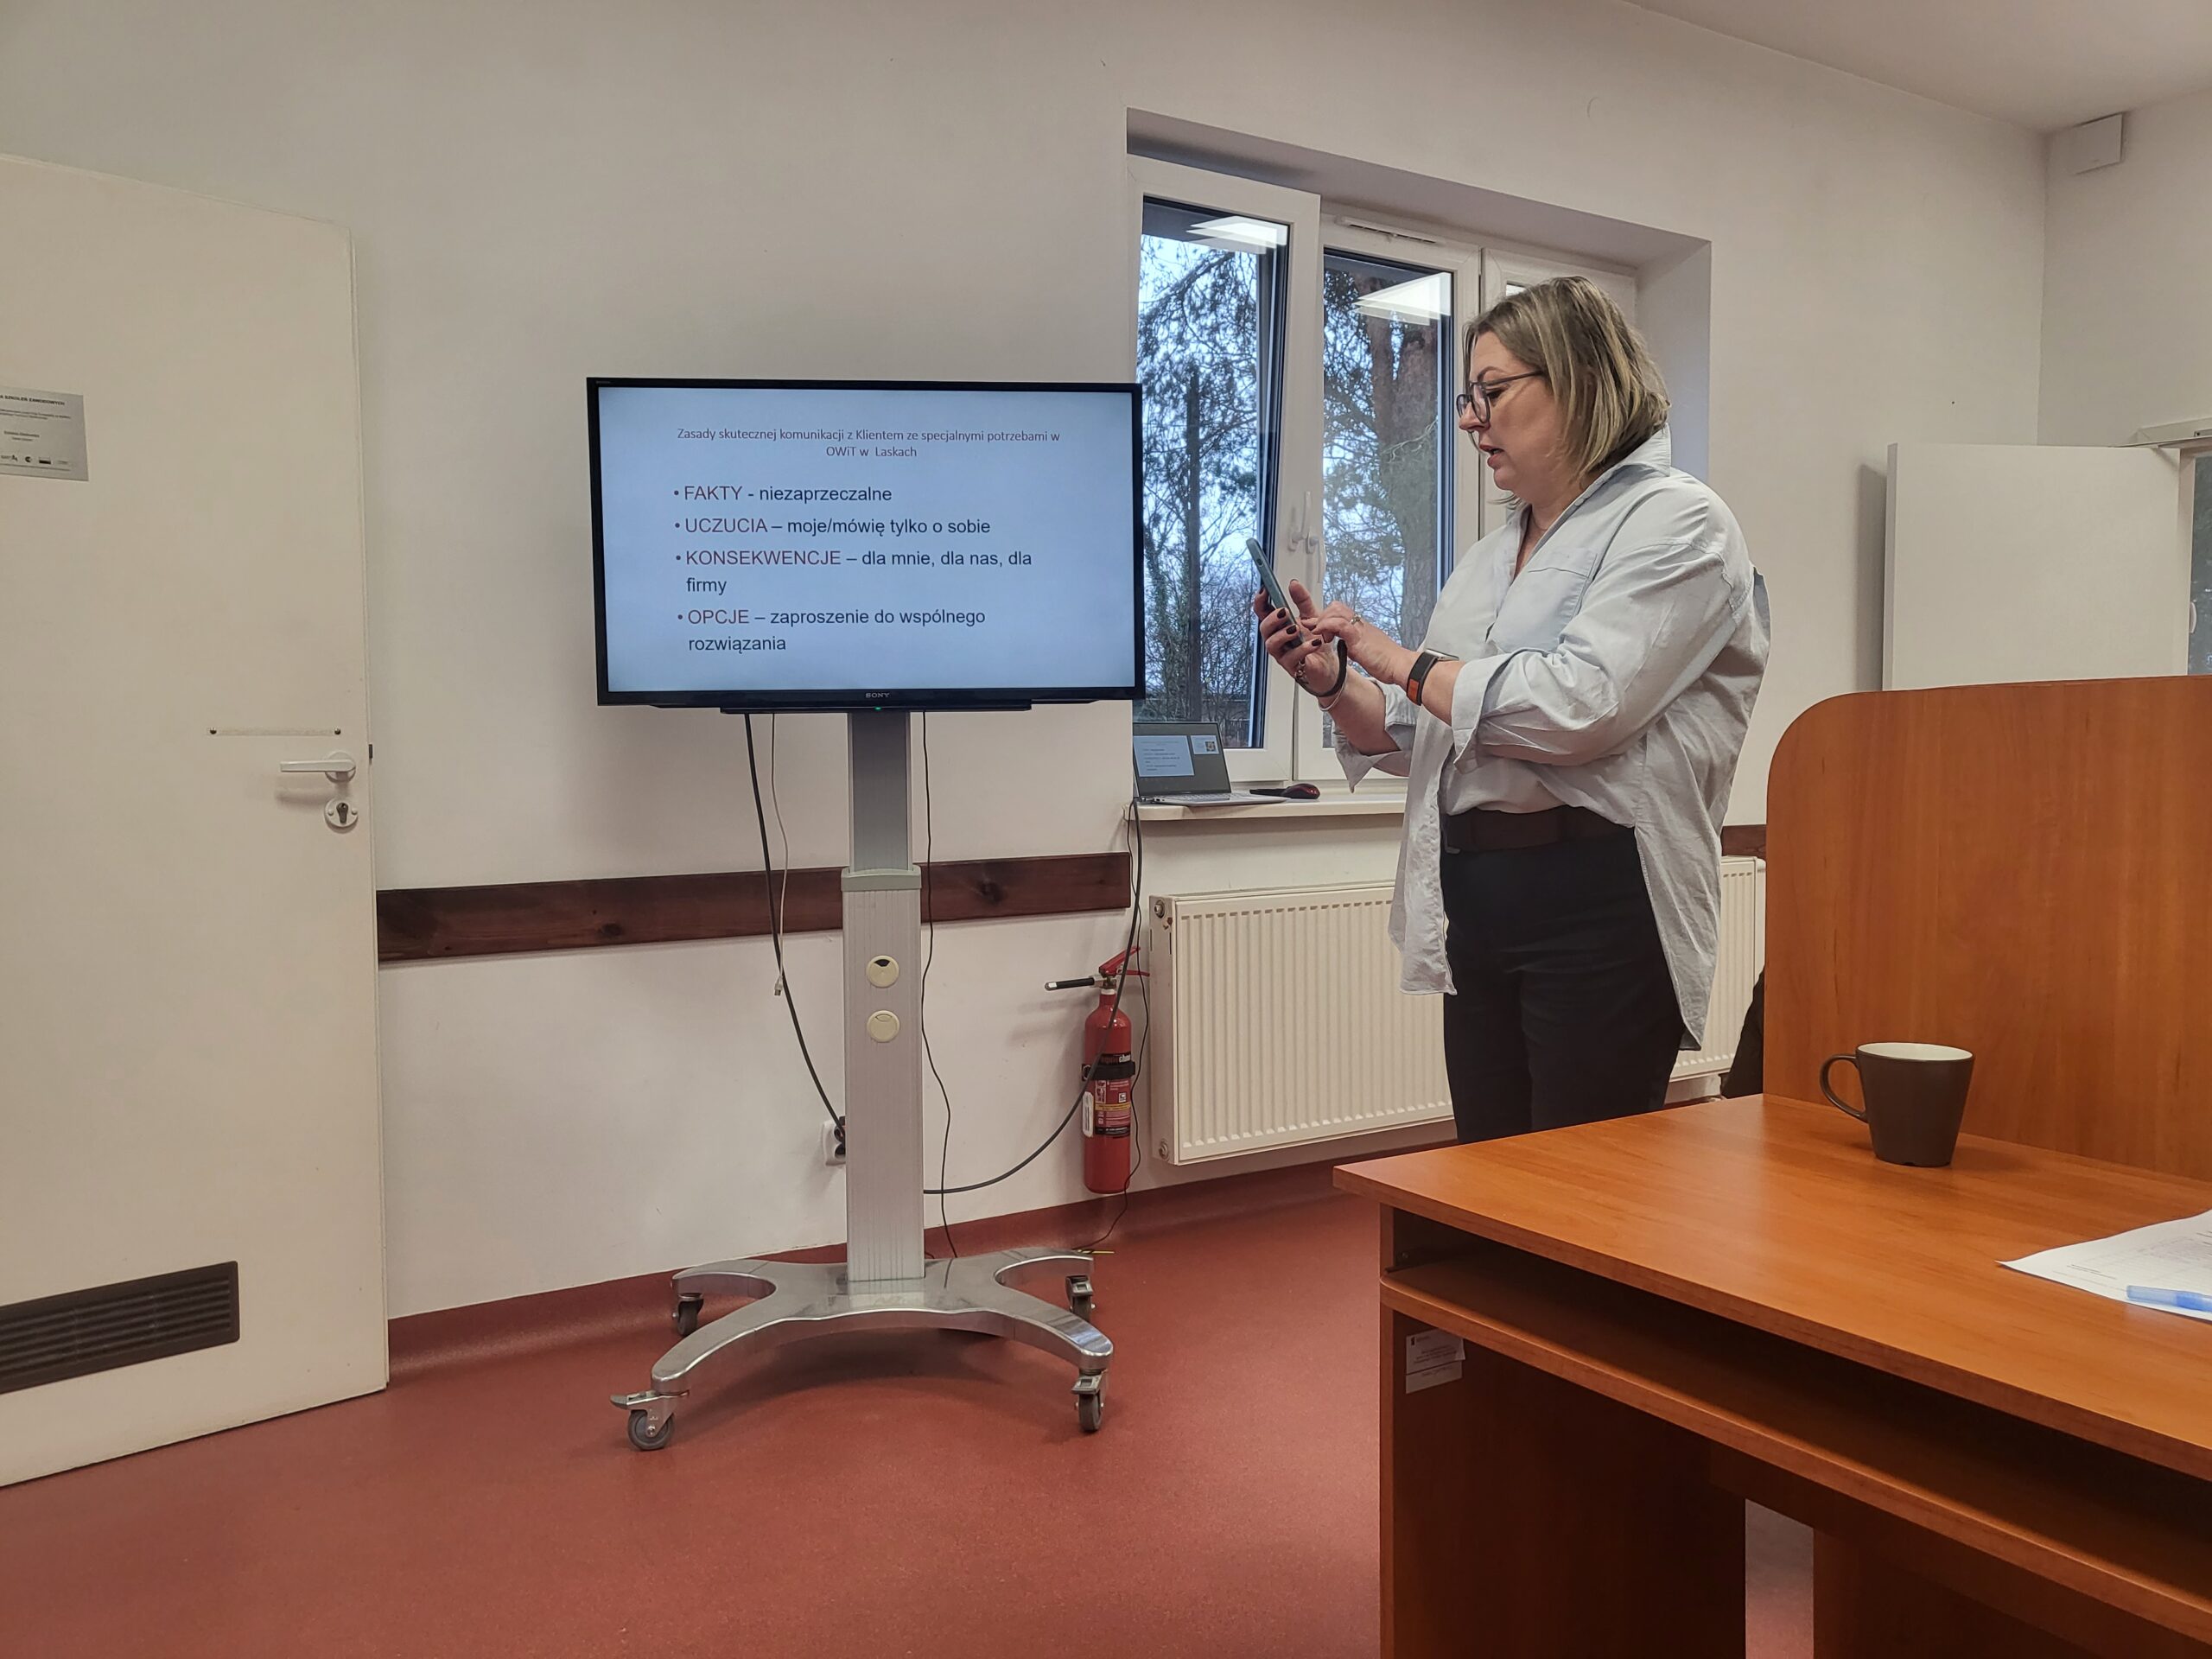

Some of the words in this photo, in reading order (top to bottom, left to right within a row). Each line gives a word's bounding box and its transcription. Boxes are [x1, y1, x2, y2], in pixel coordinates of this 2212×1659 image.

[677, 428, 715, 441] Zasady
[719, 428, 777, 442] skutecznej
[779, 429, 844, 442] komunikacji
[855, 429, 904, 441] Klientem
[921, 430, 984, 442] specjalnymi
[987, 430, 1048, 443] potrzebami
[826, 446, 856, 457] OWiT
[860, 448, 869, 457] w
[875, 446, 918, 457] Laskach
[684, 486, 743, 501] FAKTY
[760, 486, 893, 503] niezaprzeczalne
[685, 518, 768, 533] UCZUCIA
[787, 518, 886, 537] moje/mówię
[889, 518, 928, 537] tylko
[932, 522, 943, 533] o
[947, 518, 991, 534] sobie
[686, 550, 842, 566] KONSEKWENCJE
[861, 550, 887, 566] dla
[891, 550, 935, 568] mnie,
[940, 550, 965, 566] dla
[969, 554, 1003, 568] nas,
[1007, 550, 1033, 566] dla
[686, 576, 727, 594] firmy
[688, 608, 750, 625] OPCJE
[770, 608, 869, 626] zaproszenie
[874, 608, 895, 624] do
[899, 608, 986, 626] wspólnego
[689, 635, 786, 653] rozwiązania
